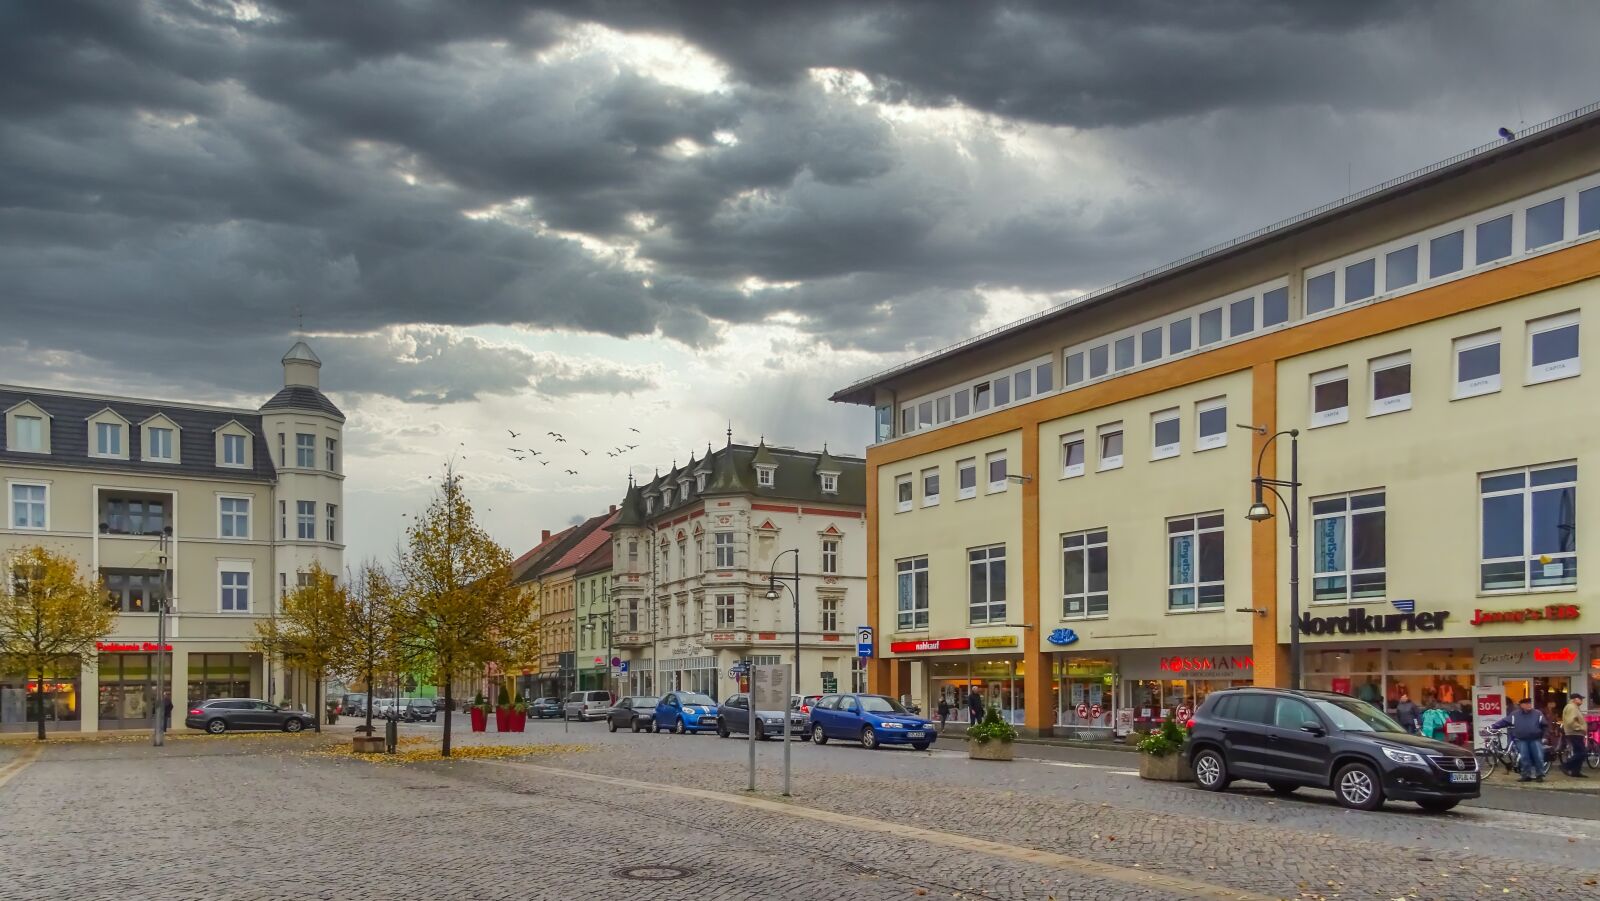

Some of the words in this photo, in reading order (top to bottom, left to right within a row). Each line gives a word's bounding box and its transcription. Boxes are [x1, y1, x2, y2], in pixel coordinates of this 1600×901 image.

[862, 633, 869, 643] P
[915, 641, 940, 650] nahkauf
[1160, 656, 1254, 672] ROSSMANN
[1479, 702, 1500, 711] 30%
